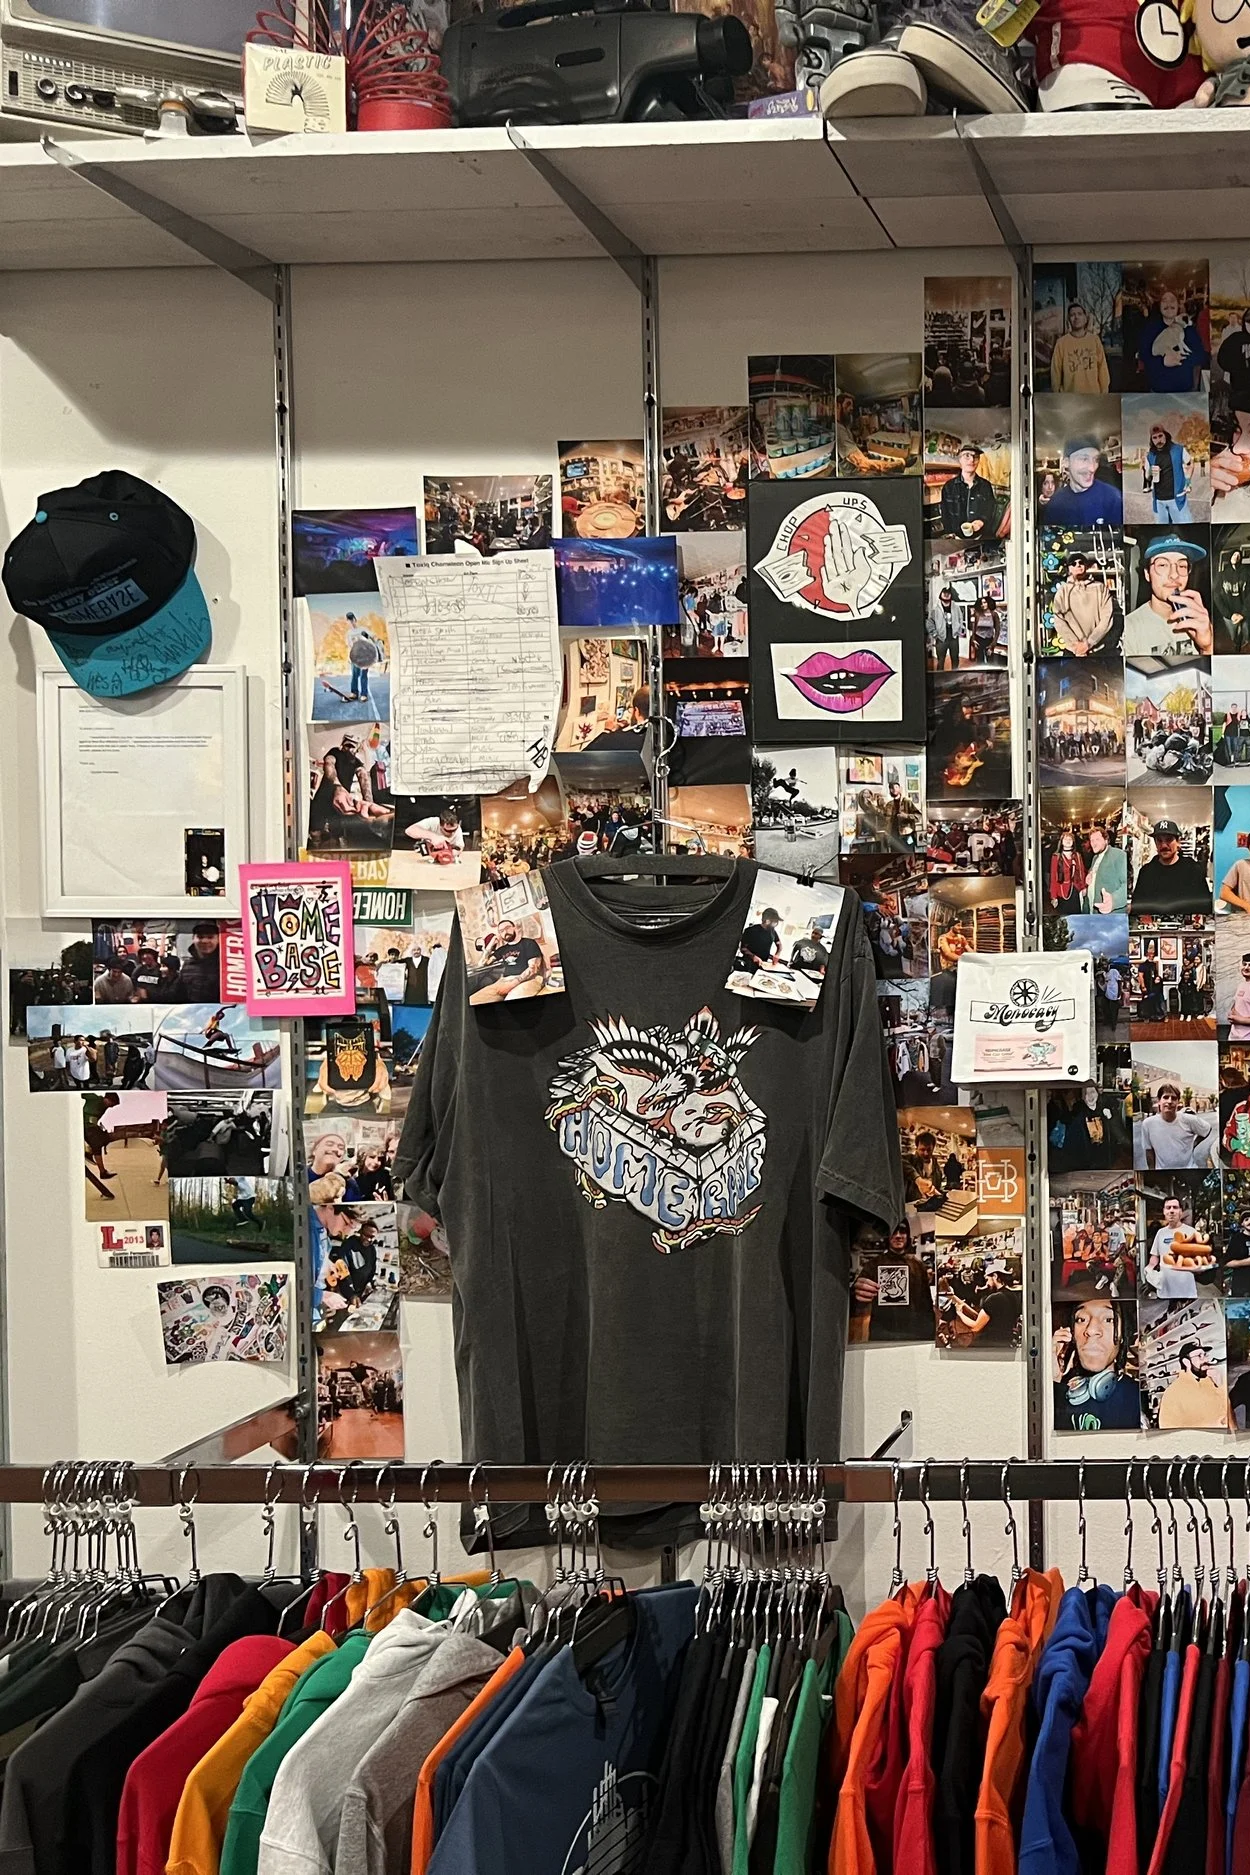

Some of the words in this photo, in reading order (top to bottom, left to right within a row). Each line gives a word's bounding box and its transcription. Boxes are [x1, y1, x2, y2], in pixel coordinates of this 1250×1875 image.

[263, 55, 332, 71] PLASTIC
[776, 516, 798, 552] CHOP
[843, 497, 867, 510] UPS
[465, 560, 481, 568] Open
[492, 559, 505, 567] Sign
[526, 737, 549, 769] HB
[250, 893, 341, 947] HOME
[255, 942, 341, 990] BASE
[983, 1004, 1060, 1033] Monocacy
[563, 1109, 690, 1227] HOME
[101, 1226, 124, 1250] L
[124, 1235, 145, 1245] 2013
